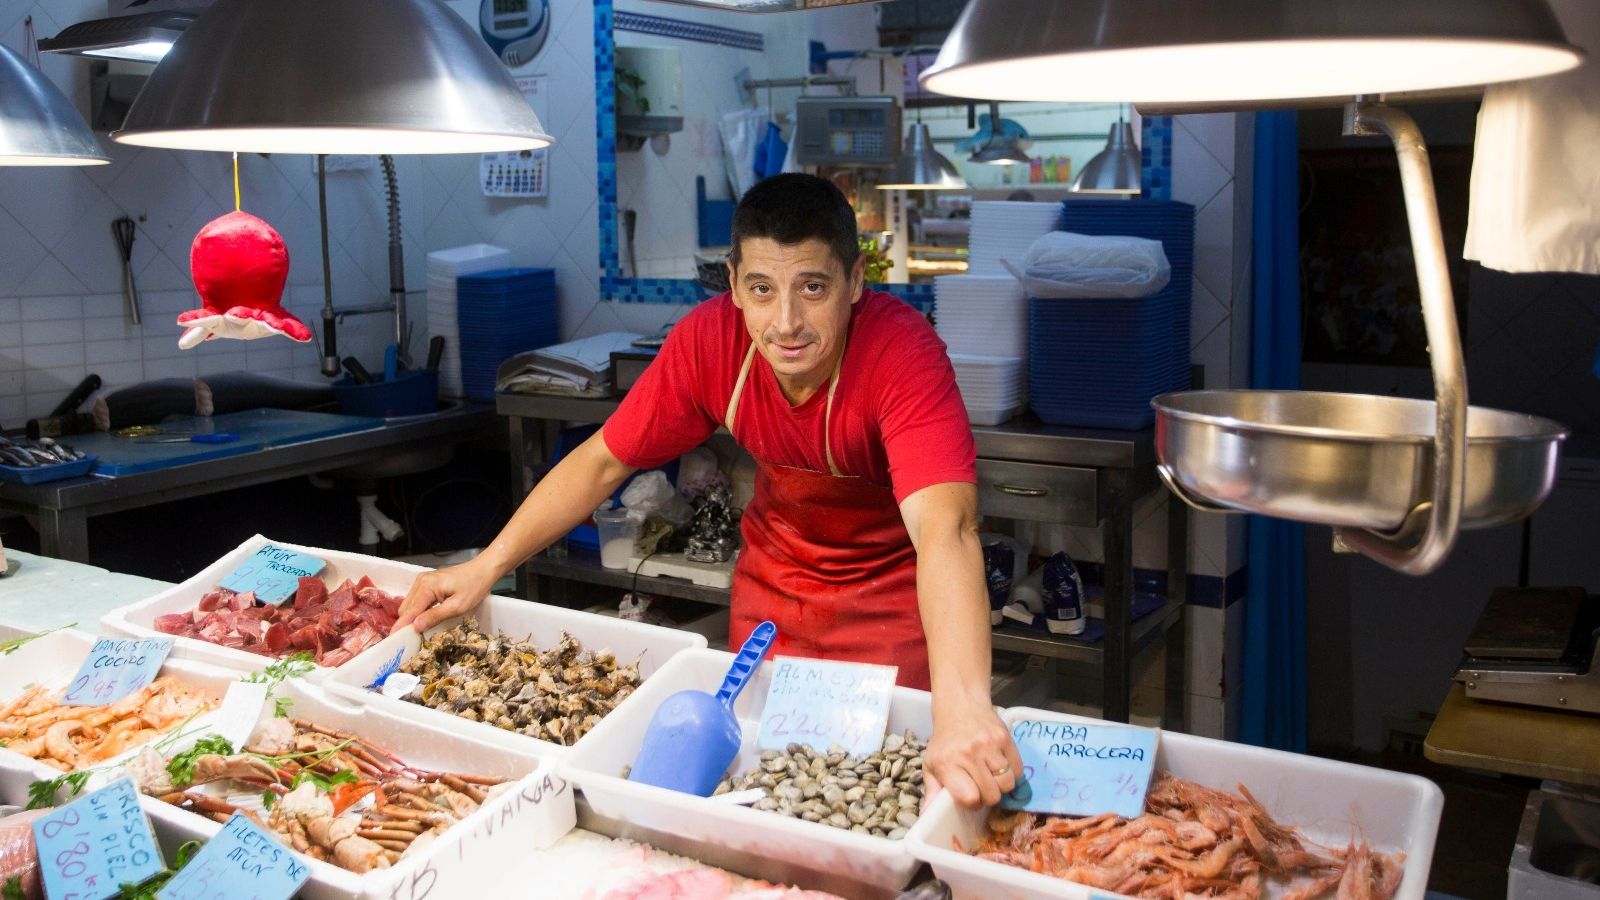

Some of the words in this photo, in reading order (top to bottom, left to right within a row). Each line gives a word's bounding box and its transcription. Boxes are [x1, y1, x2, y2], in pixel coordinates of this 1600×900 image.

[93, 655, 147, 669] COCIDO
[776, 663, 885, 688] ALMEJ
[64, 671, 119, 701] 2'95
[1013, 721, 1088, 744] GAMBA
[1048, 743, 1145, 762] ARROCERA
[90, 792, 109, 821] SIN
[100, 832, 127, 879] PIEL
[111, 779, 150, 867] FRESCO
[224, 813, 282, 863] FILETES
[285, 857, 306, 882] DE
